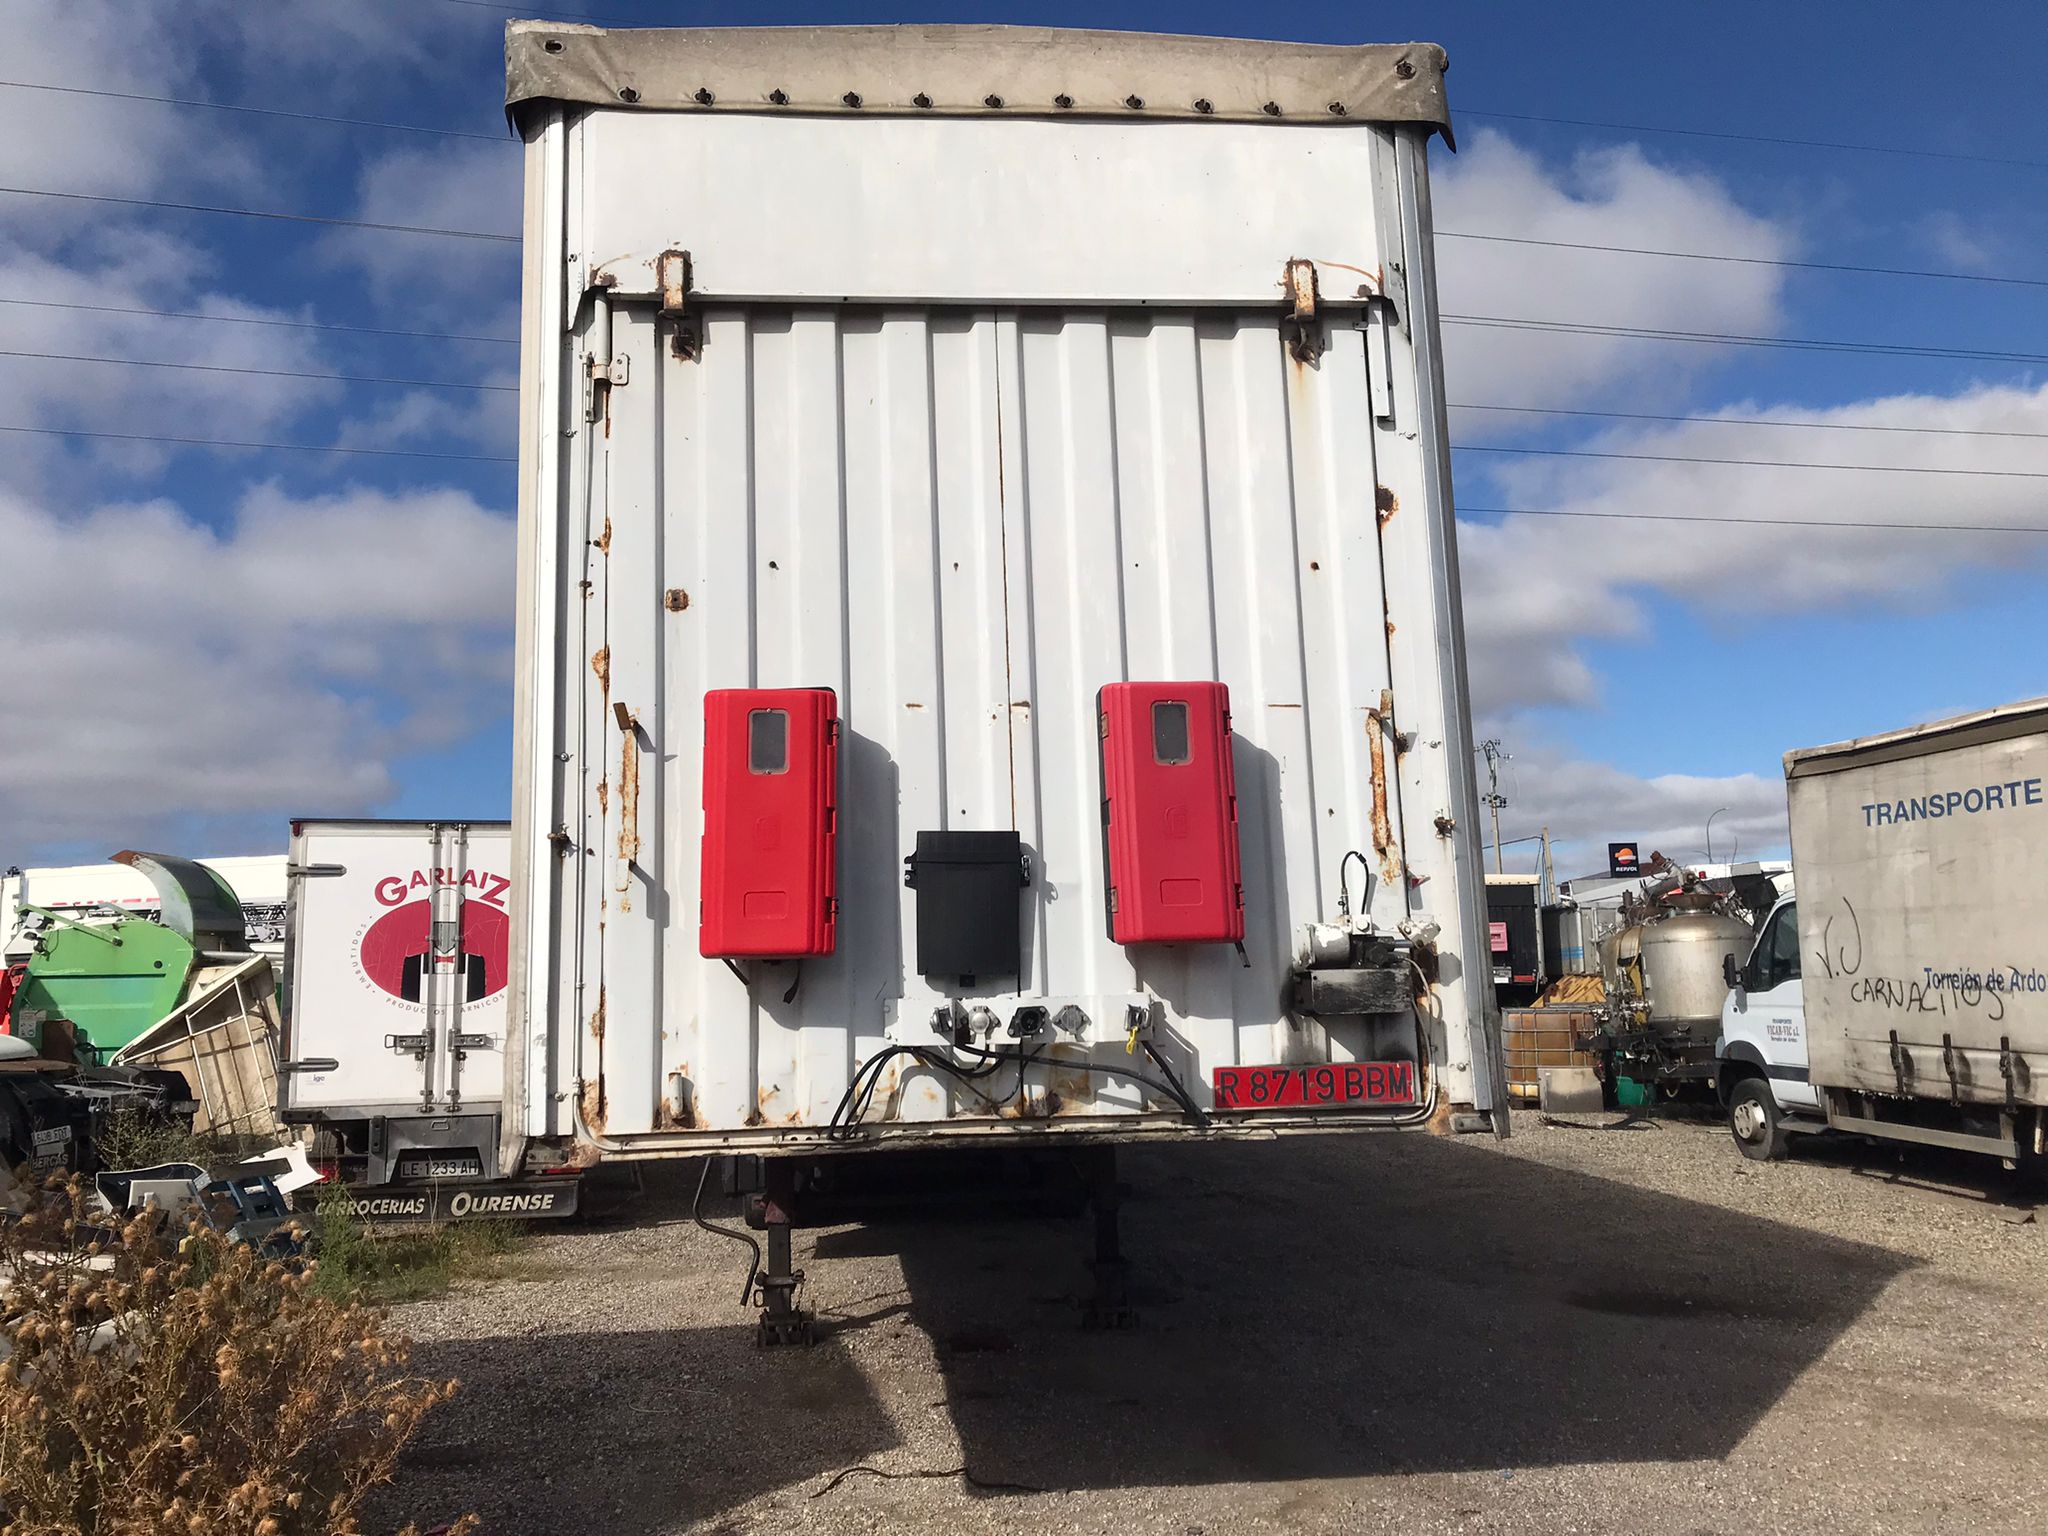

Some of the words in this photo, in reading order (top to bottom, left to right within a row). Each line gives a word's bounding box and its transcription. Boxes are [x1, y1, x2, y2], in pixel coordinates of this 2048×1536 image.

[1861, 778, 2043, 827] TRANSPORTE
[374, 867, 511, 908] GARLAIZ
[1986, 967, 2005, 992] de
[385, 997, 446, 1016] PRODUCOS
[459, 993, 505, 1014] ARNICOS
[1219, 1072, 1240, 1104] R
[1250, 1068, 1335, 1103] 8719
[1344, 1066, 1407, 1100] BBM
[450, 1191, 554, 1217] OURENSE
